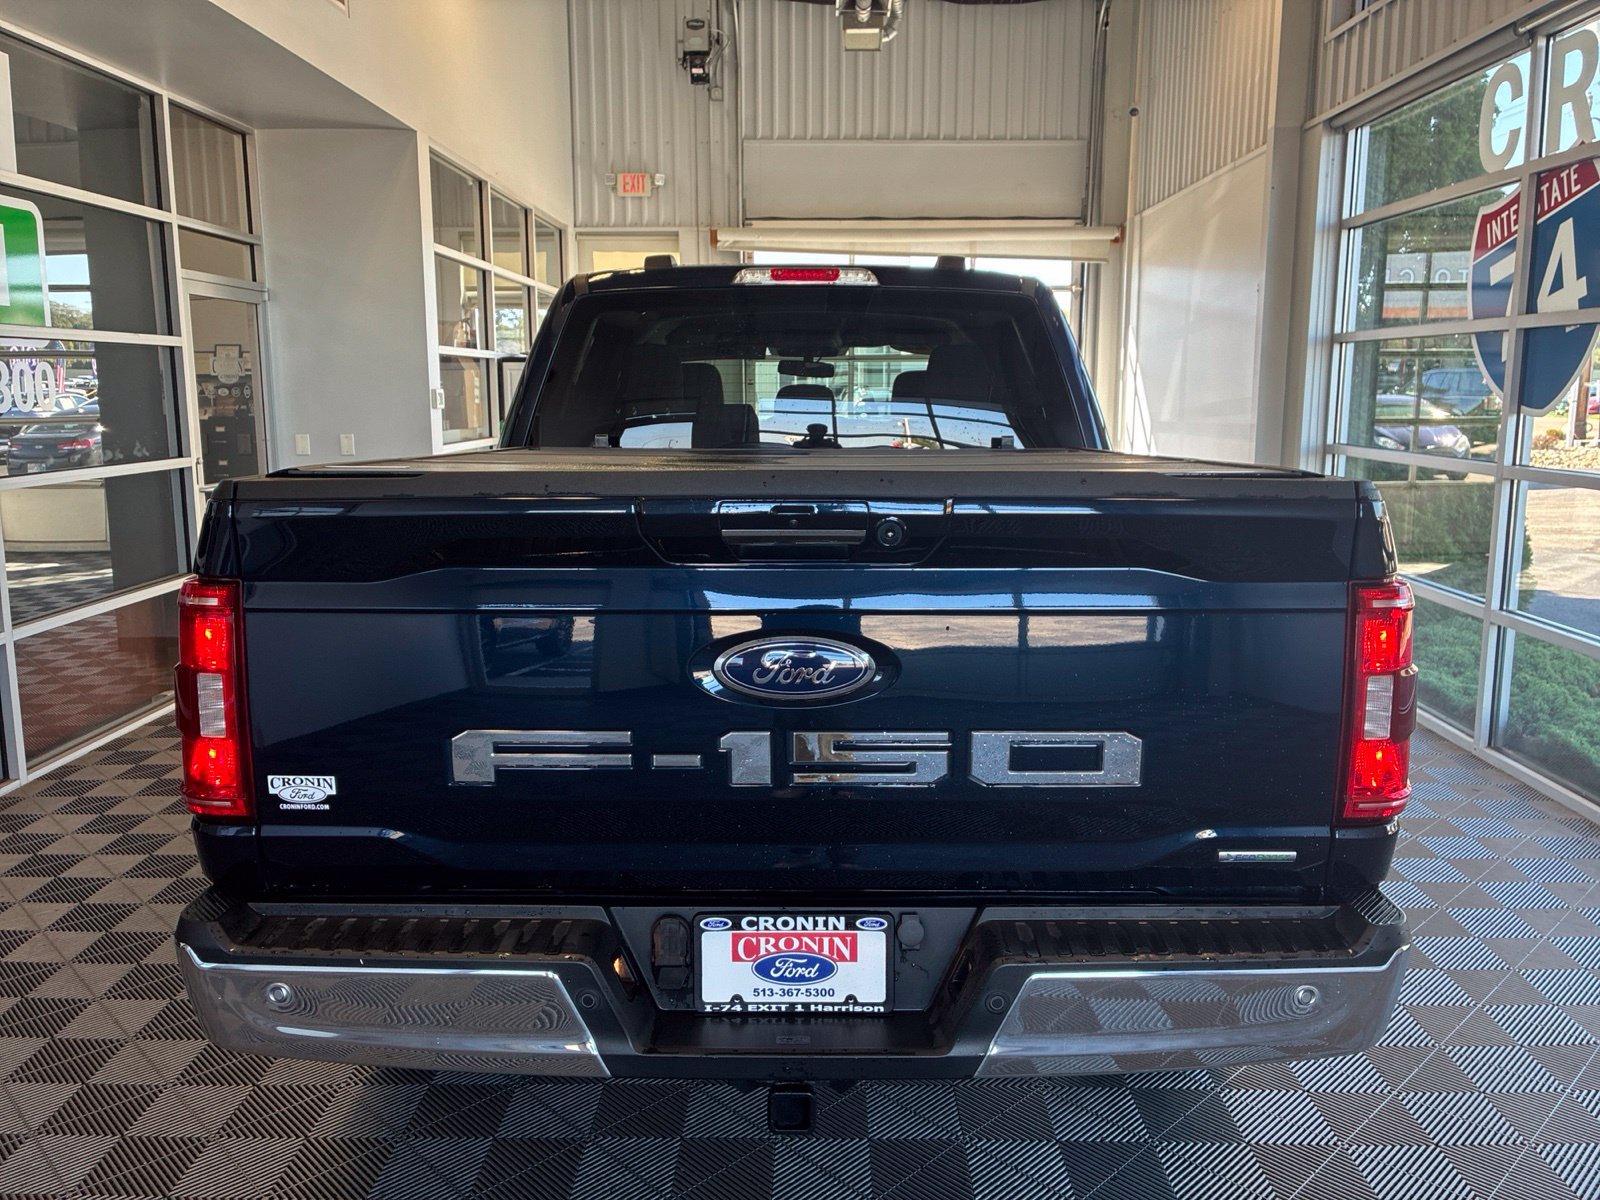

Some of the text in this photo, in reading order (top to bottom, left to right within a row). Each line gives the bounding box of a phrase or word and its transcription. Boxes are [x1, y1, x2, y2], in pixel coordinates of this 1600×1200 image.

[622, 173, 646, 193] EXIT
[1487, 164, 1581, 249] INTETATE
[752, 650, 837, 684] Ford
[450, 730, 1142, 786] F-150
[270, 776, 334, 791] CRONIN
[289, 788, 316, 800] Ford
[741, 916, 845, 931] CRONIN
[737, 936, 852, 961] CRONIN
[770, 957, 819, 978] Ford
[753, 988, 835, 997] 513-367-5300
[704, 1004, 885, 1012] I-74 EXIT 1 Harrison
